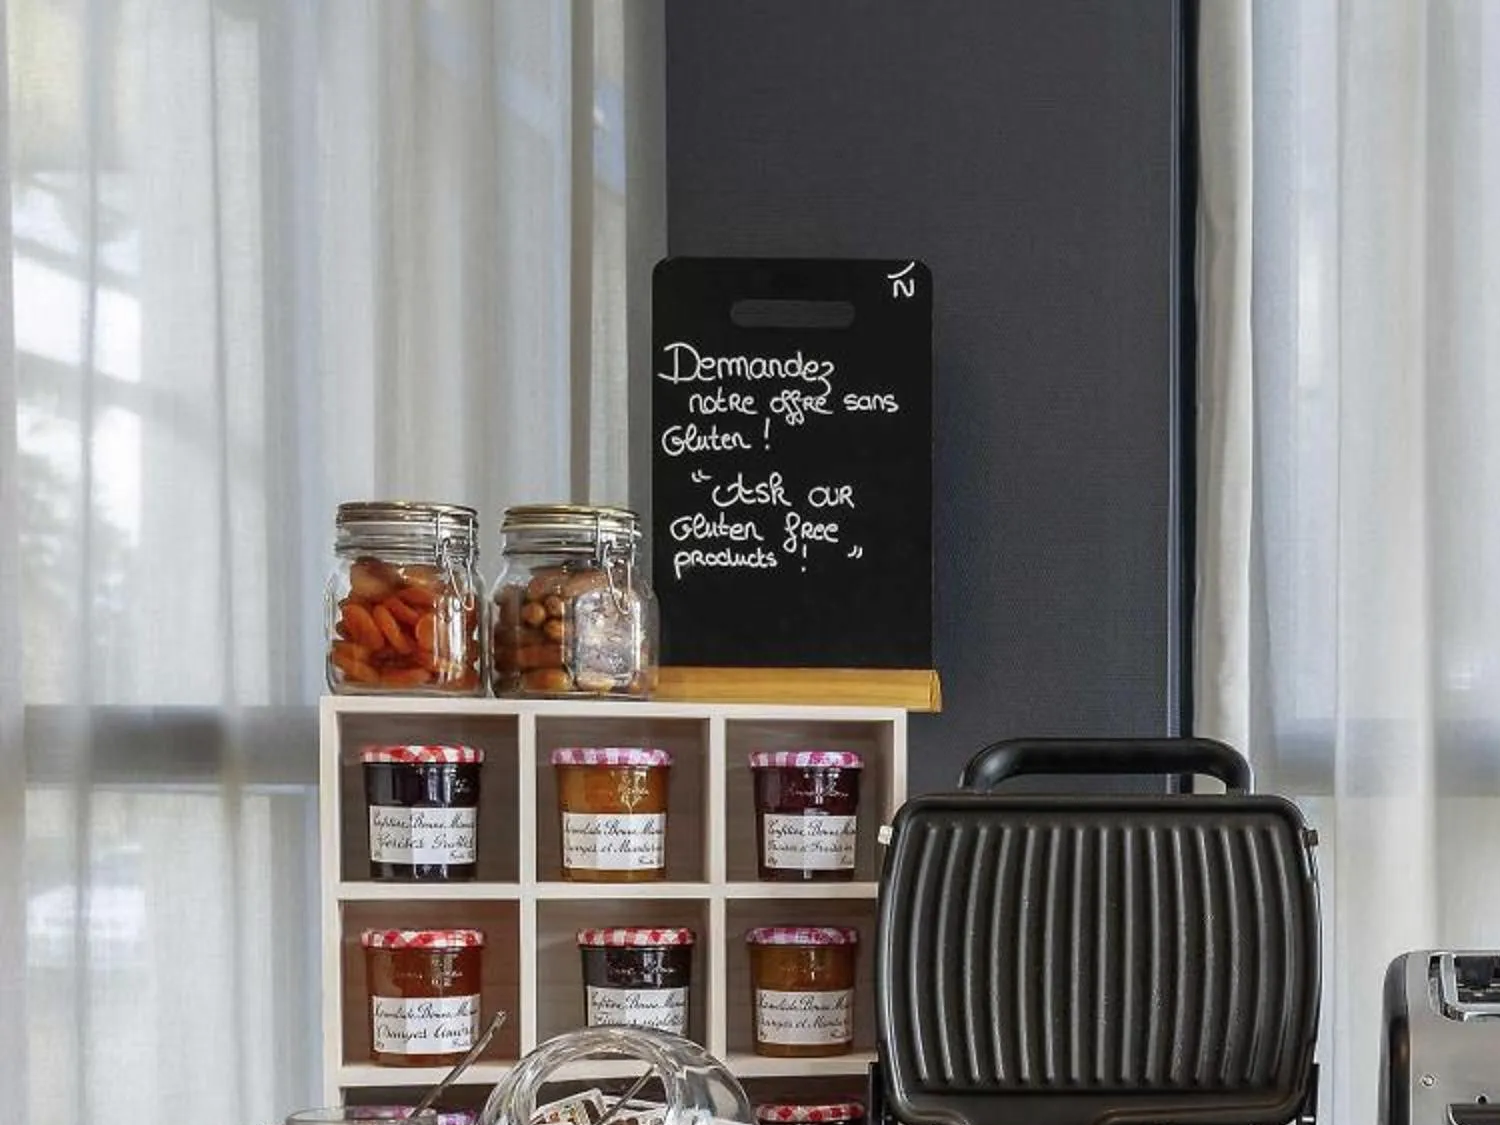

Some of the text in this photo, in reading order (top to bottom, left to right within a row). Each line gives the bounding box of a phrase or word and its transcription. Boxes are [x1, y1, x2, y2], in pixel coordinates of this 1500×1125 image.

[657, 342, 835, 397] Demandez
[688, 386, 900, 426] notre offre sans
[661, 422, 752, 457] Gluten
[673, 546, 778, 580] products
